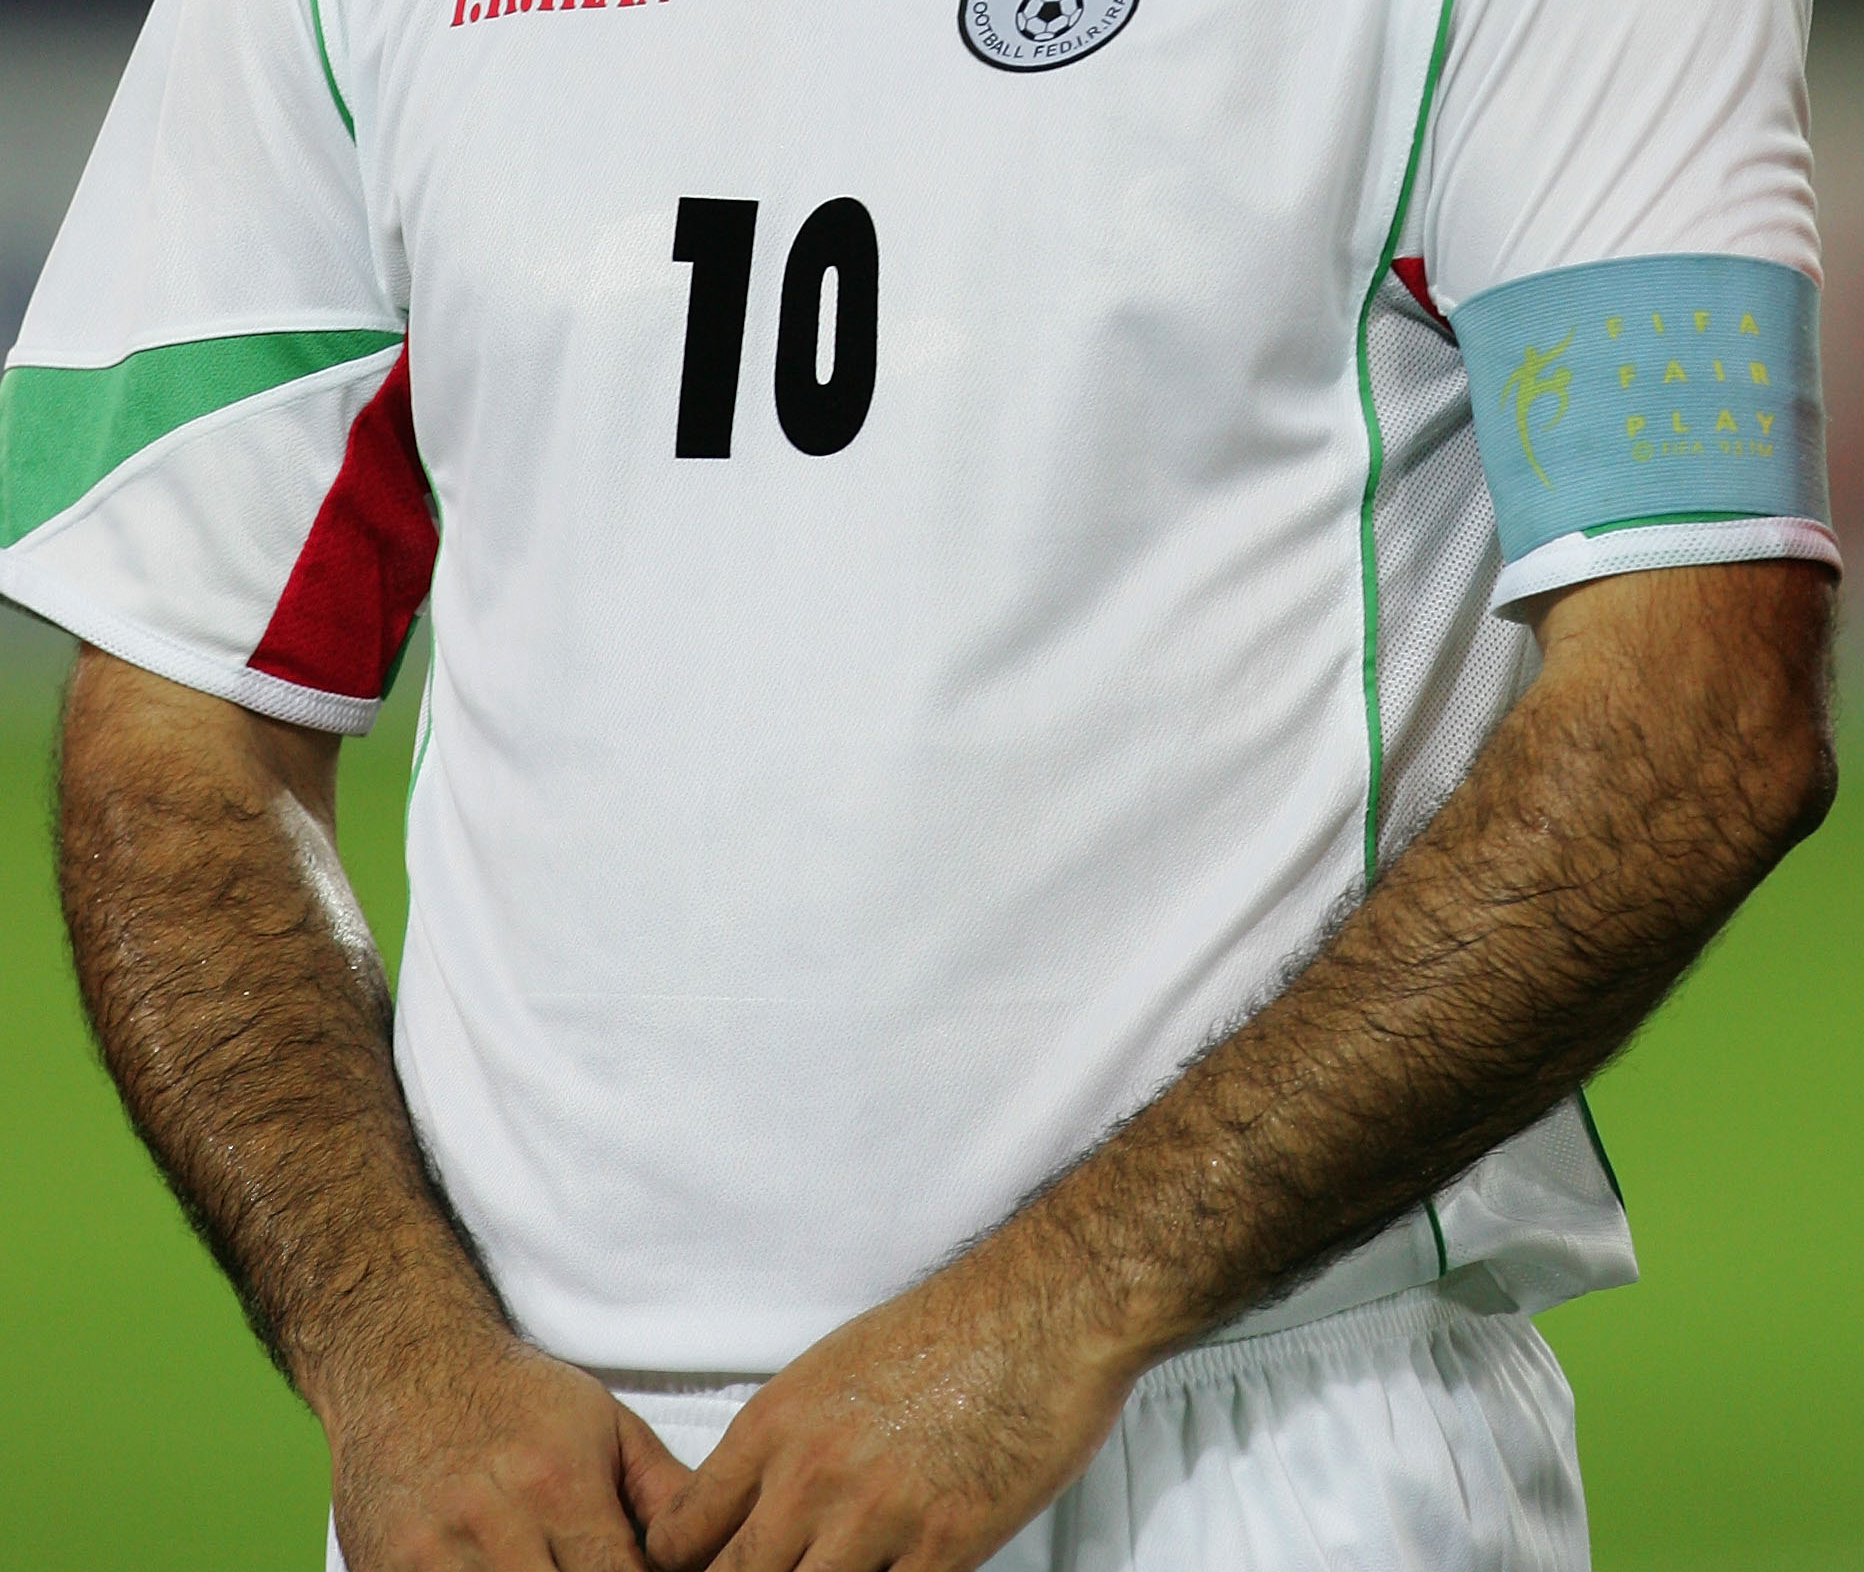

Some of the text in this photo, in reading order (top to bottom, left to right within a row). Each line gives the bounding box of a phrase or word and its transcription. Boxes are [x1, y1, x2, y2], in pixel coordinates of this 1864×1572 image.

[673, 197, 878, 458] 10
[1606, 310, 1759, 338] FIFA
[1619, 359, 1769, 388] FAIR
[1626, 409, 1775, 437] PLAY
